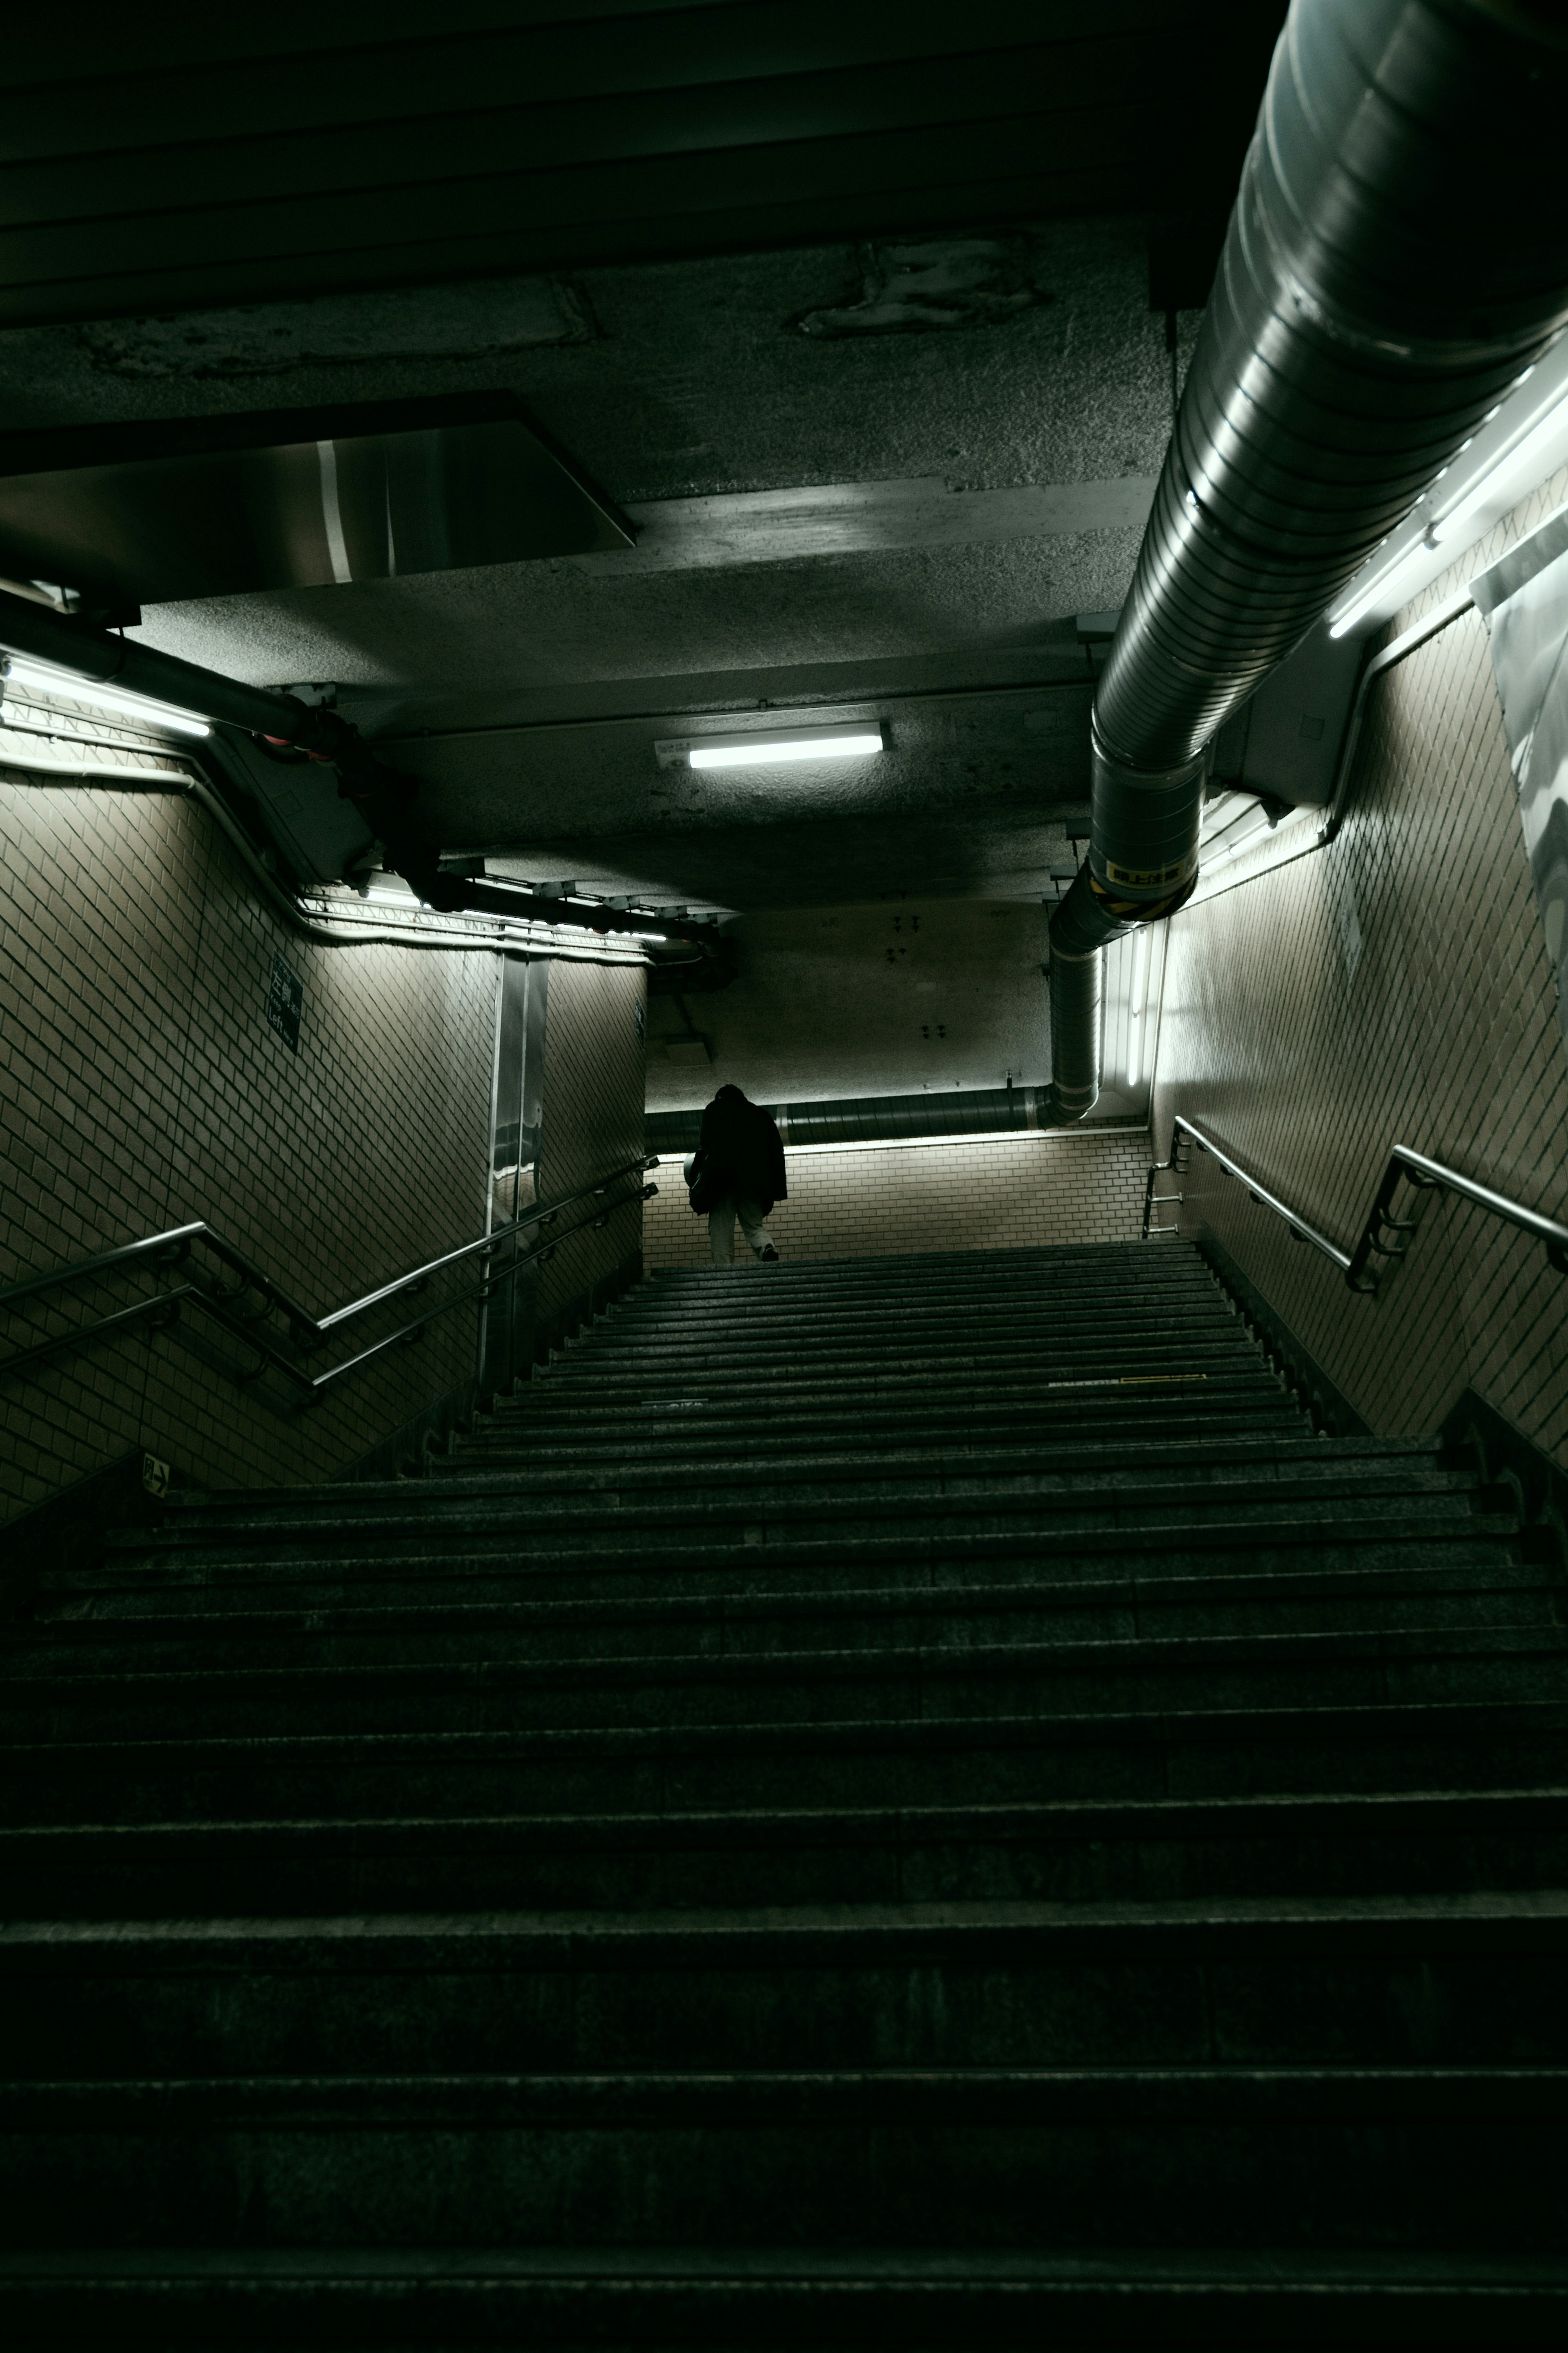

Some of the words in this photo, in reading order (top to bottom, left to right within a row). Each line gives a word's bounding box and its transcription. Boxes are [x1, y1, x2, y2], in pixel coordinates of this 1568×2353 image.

[1114, 868, 1179, 884] 頭上注意
[269, 1006, 283, 1034] Left
